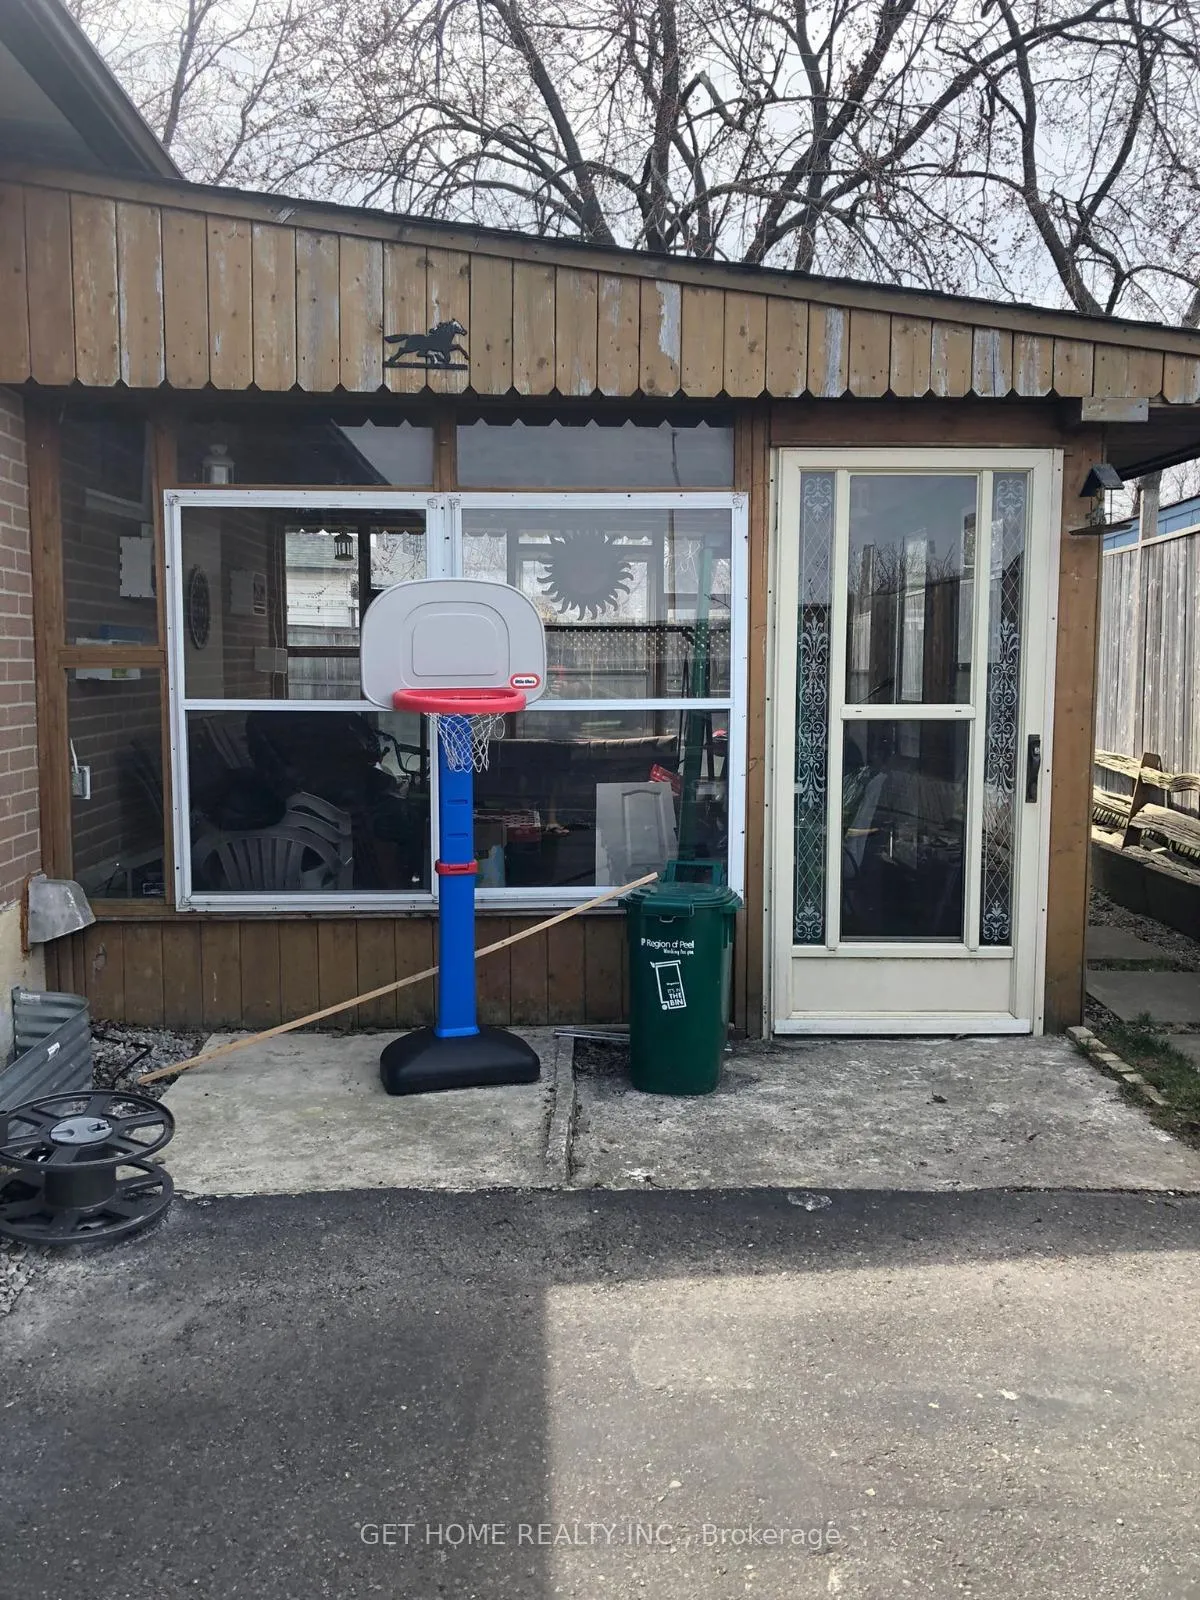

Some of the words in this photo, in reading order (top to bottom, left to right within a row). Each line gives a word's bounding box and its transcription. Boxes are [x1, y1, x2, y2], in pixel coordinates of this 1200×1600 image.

[646, 938, 671, 950] Region
[671, 939, 679, 948] of
[679, 940, 695, 949] Peel
[668, 992, 682, 1000] THE
[669, 998, 684, 1006] BIN
